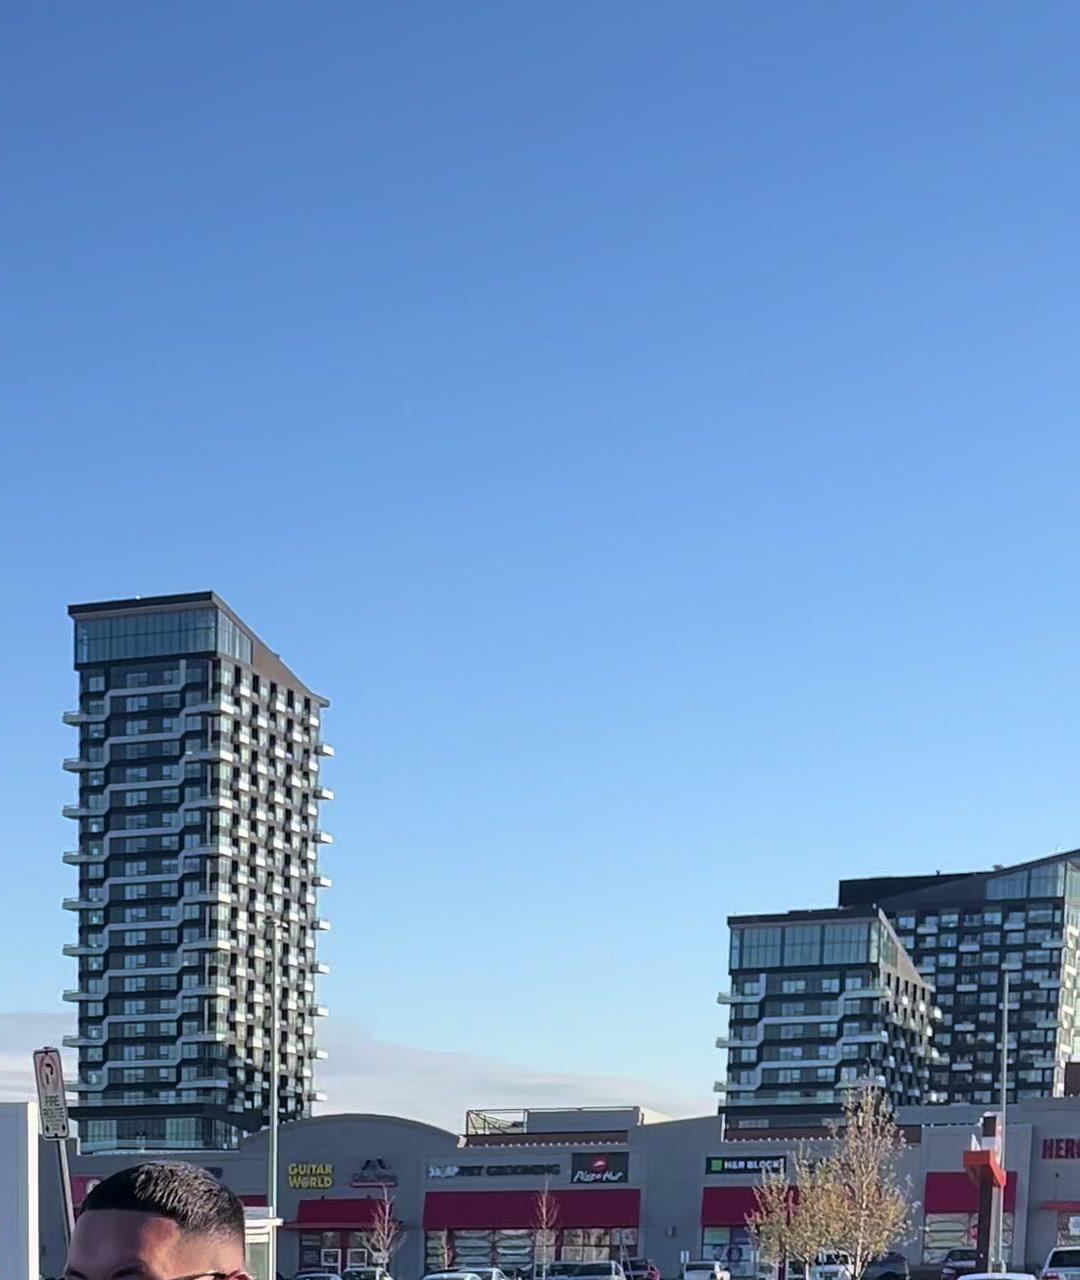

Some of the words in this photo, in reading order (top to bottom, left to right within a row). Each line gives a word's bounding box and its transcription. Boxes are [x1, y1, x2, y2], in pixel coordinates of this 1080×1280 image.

[288, 1163, 333, 1175] GUITAR
[746, 1160, 778, 1169] BLOCK
[288, 1175, 333, 1188] WORLD
[573, 1169, 601, 1182] Pizza
